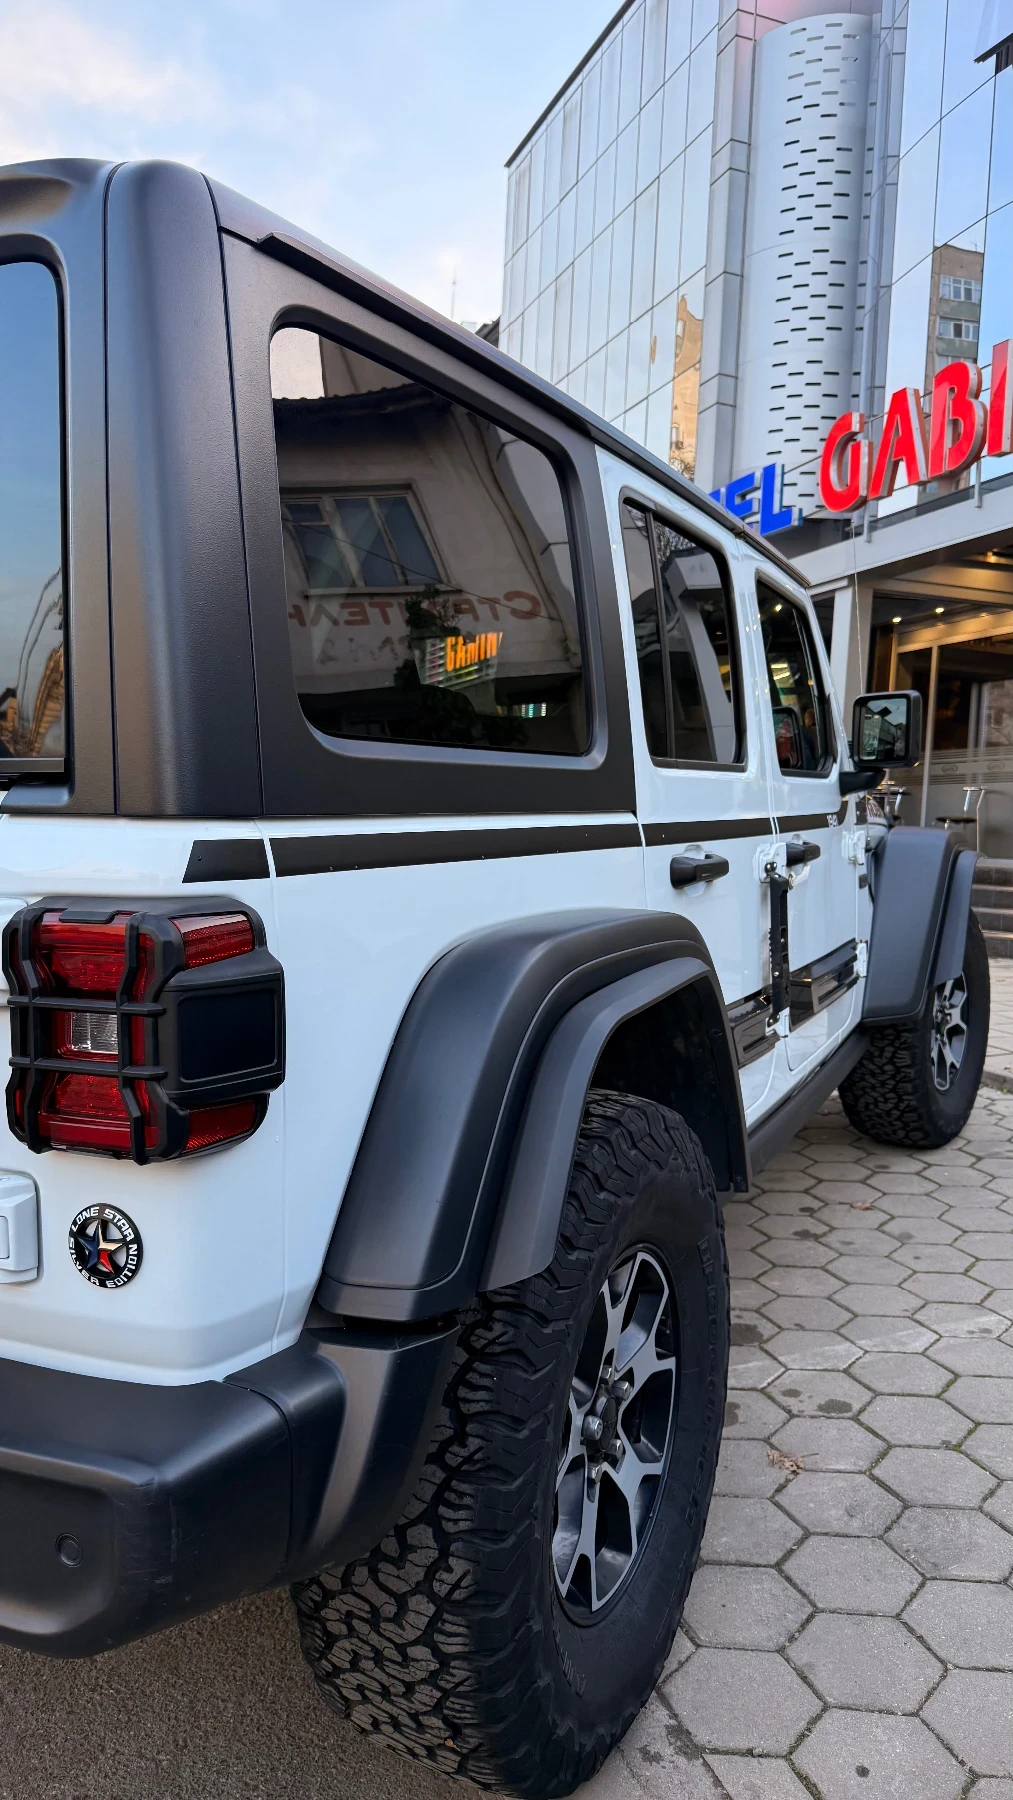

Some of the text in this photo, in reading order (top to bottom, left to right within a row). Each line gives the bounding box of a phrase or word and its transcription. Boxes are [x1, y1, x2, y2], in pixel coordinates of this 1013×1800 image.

[709, 339, 1013, 535] EL GABI
[71, 1206, 135, 1241] LONE STAR
[69, 1238, 138, 1288] SILVER EDITION
